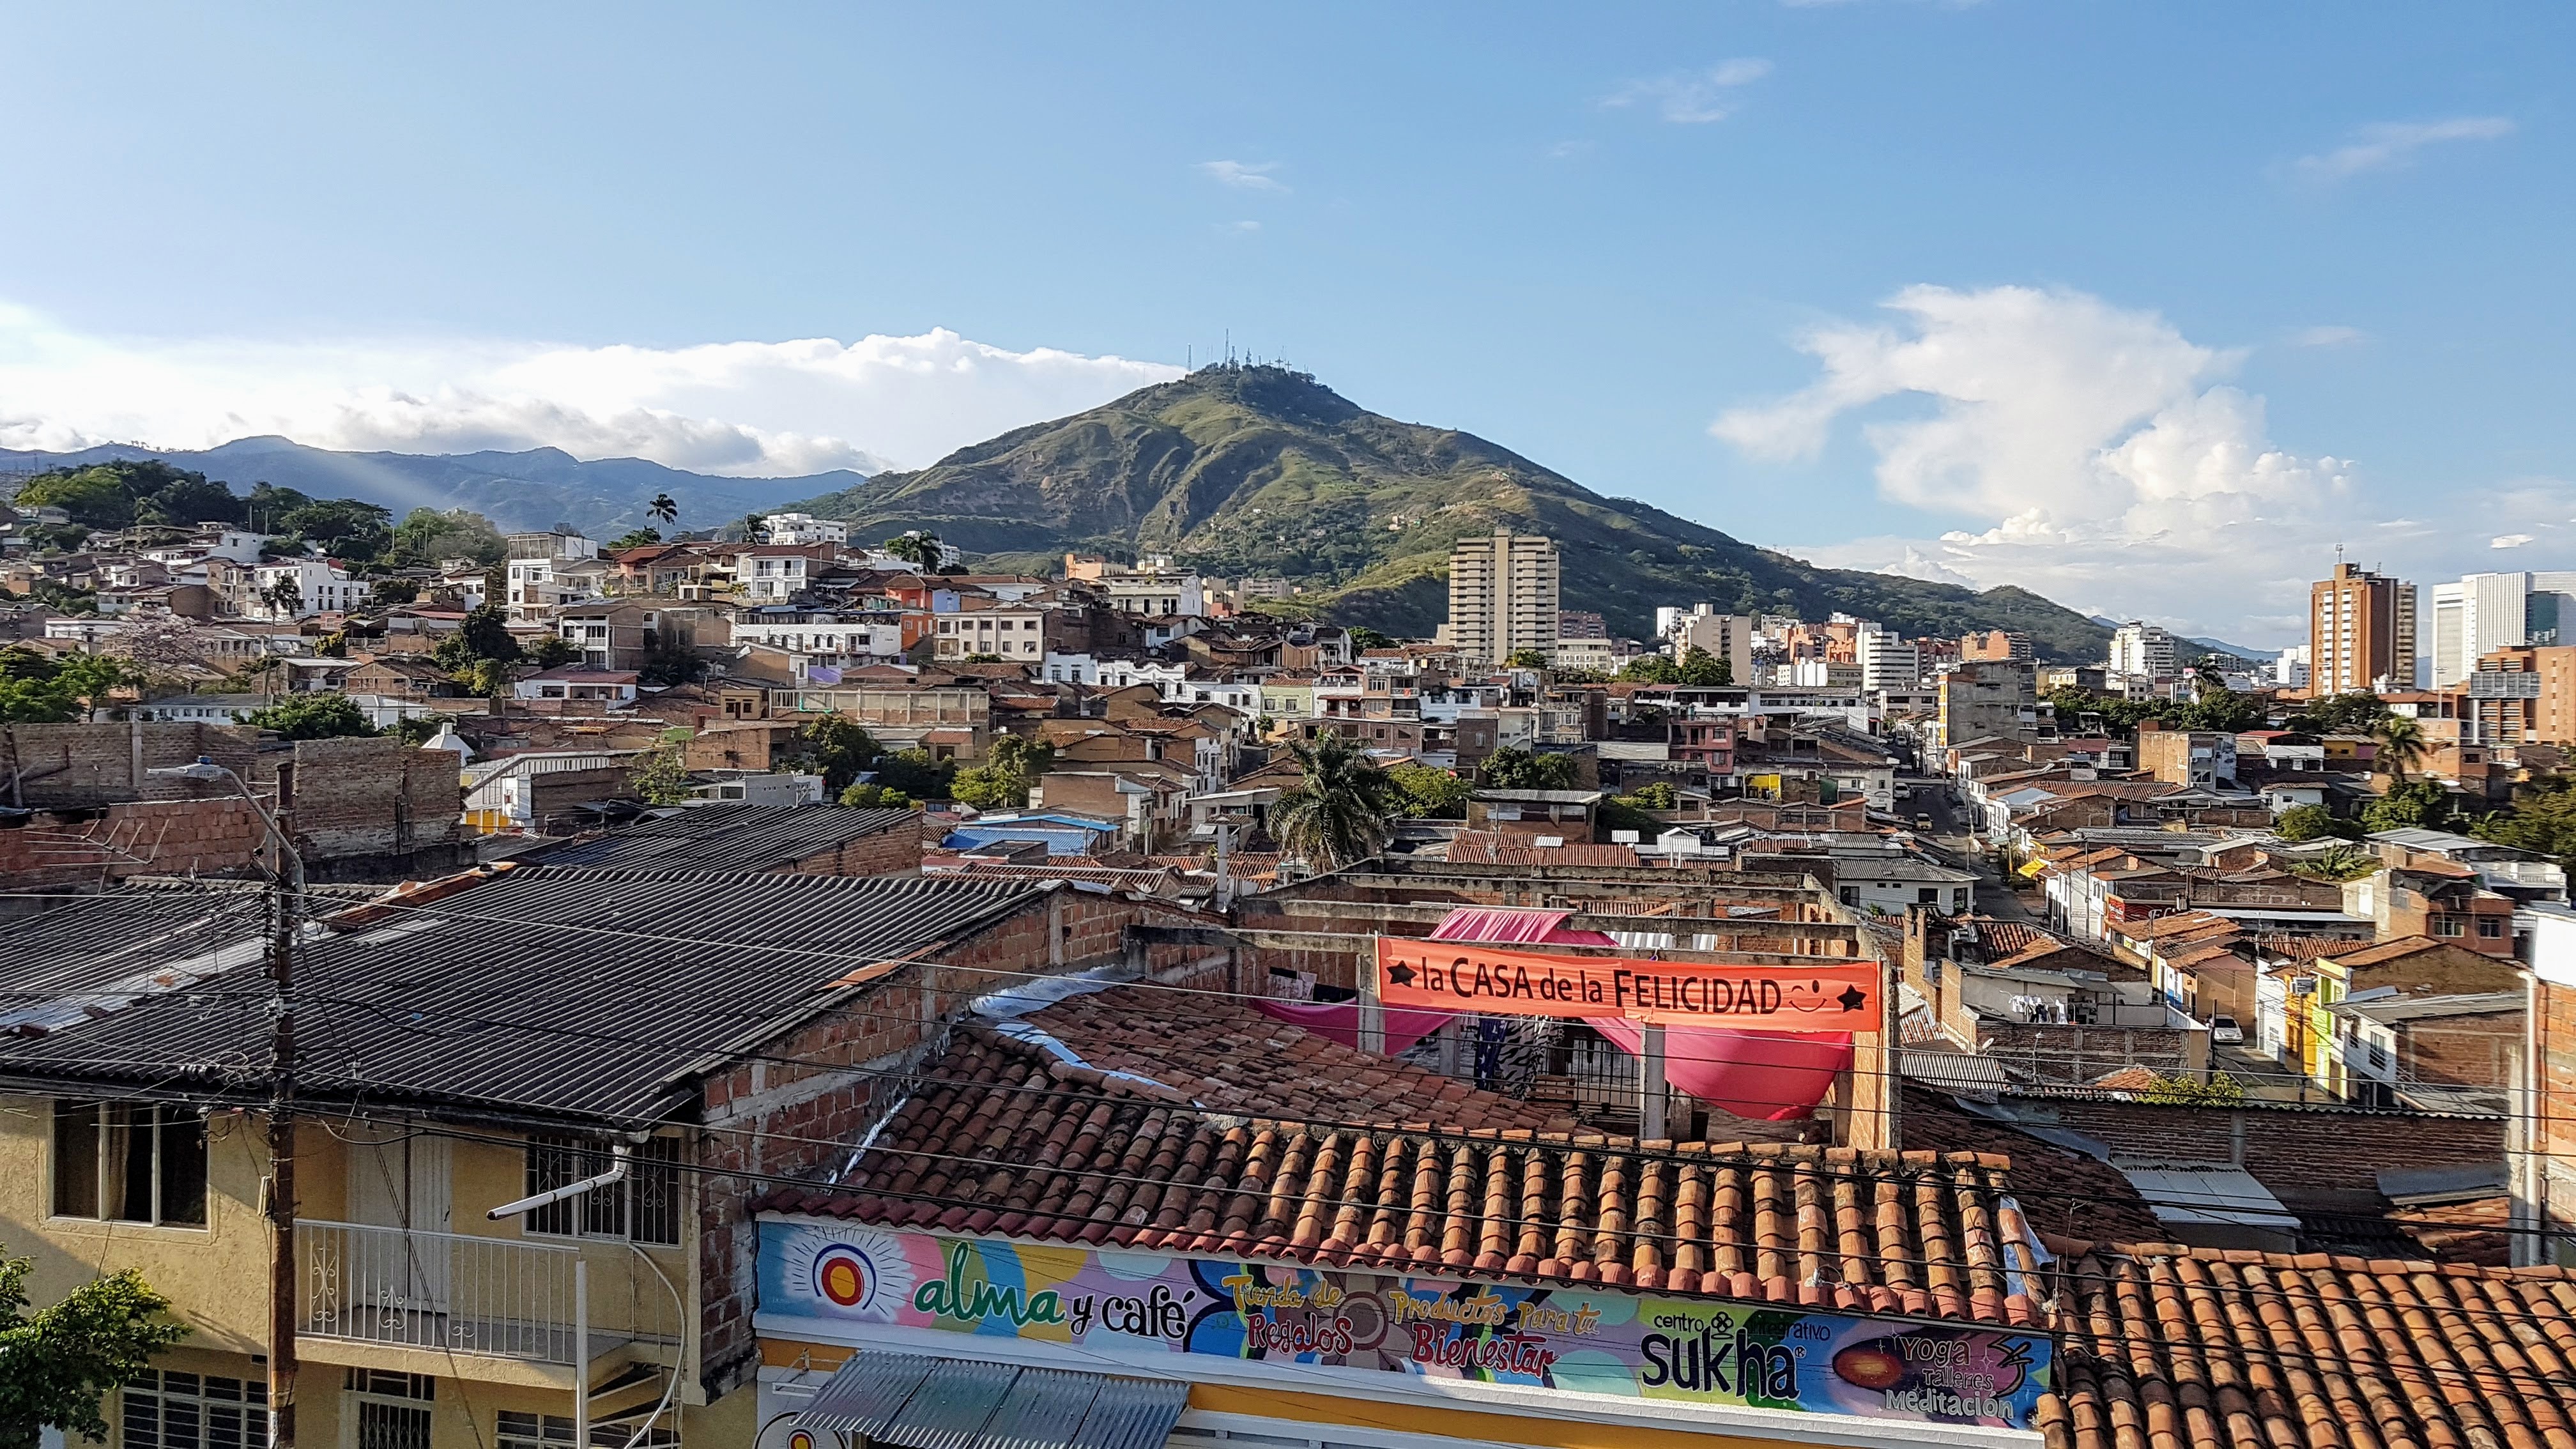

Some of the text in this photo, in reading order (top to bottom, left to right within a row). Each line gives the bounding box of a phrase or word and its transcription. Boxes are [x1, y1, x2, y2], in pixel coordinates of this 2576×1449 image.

[1422, 956, 1781, 1015] la CASA de la FELICIDAD
[913, 1241, 1197, 1338] alma y café
[1222, 1275, 1346, 1310] Tienda de
[1388, 1284, 1508, 1325] Productos
[1574, 1302, 1601, 1335] tu
[1653, 1312, 1704, 1333] centro
[1412, 1322, 1560, 1378] Bienestar
[1900, 1337, 1971, 1368] Yoga
[1922, 1366, 1995, 1392] Talleres
[1885, 1388, 2014, 1420] Meditación
